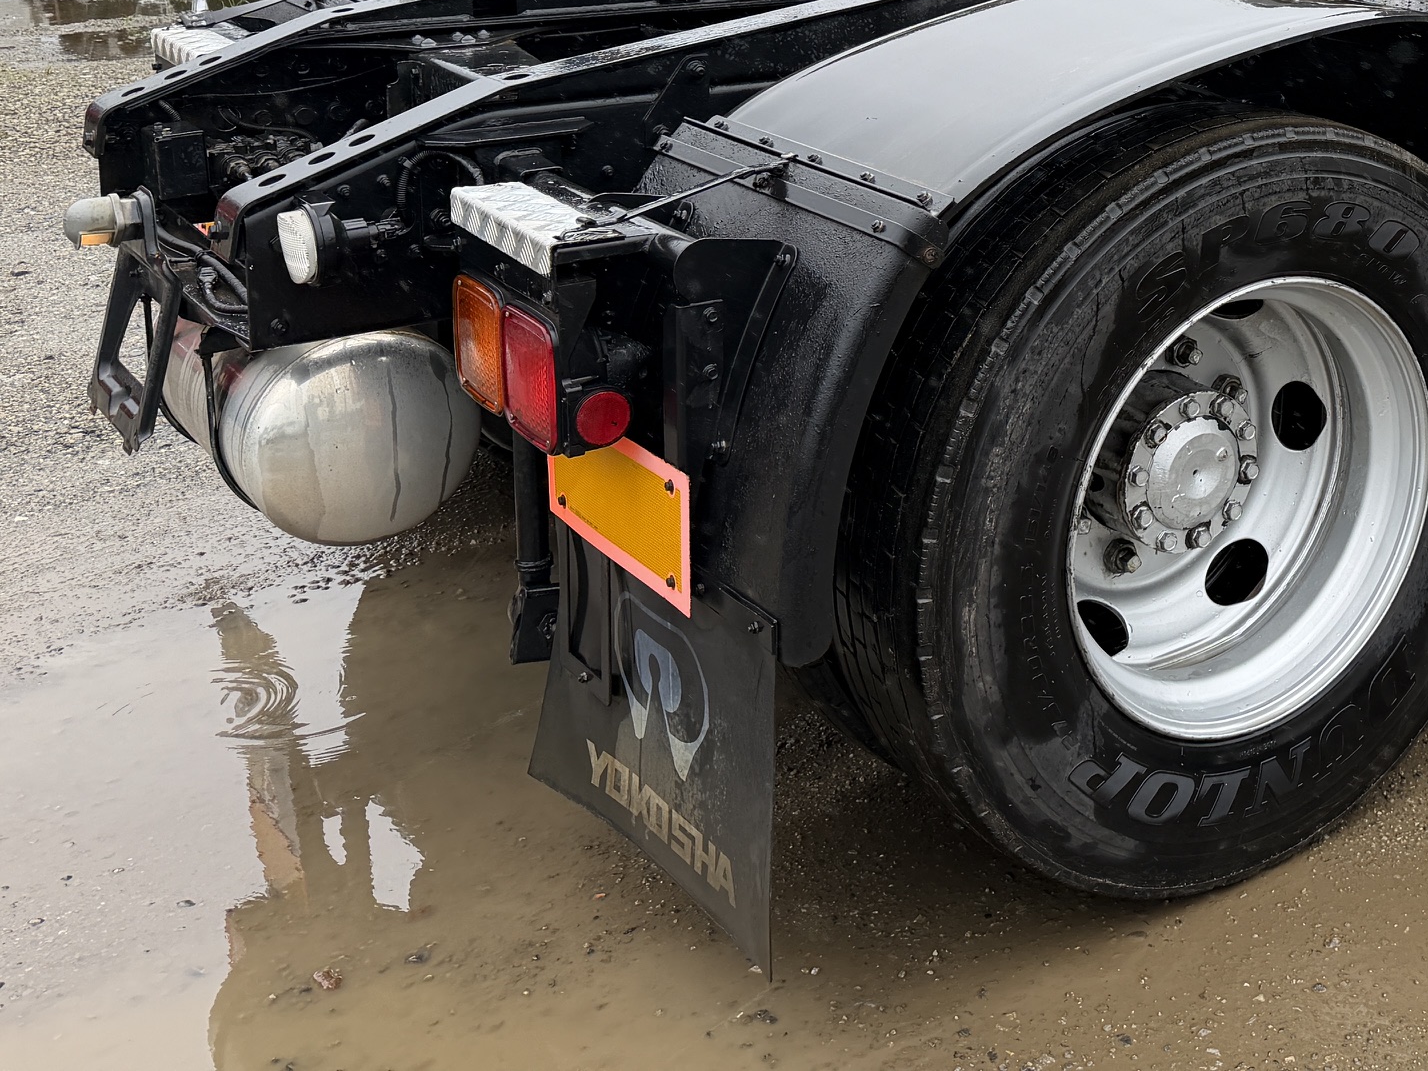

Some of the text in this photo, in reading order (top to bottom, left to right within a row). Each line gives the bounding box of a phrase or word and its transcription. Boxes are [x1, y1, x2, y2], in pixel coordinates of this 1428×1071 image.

[1135, 200, 1421, 323] SP680
[1067, 633, 1417, 827] DUNLOP
[585, 738, 737, 909] YOKOSHA
